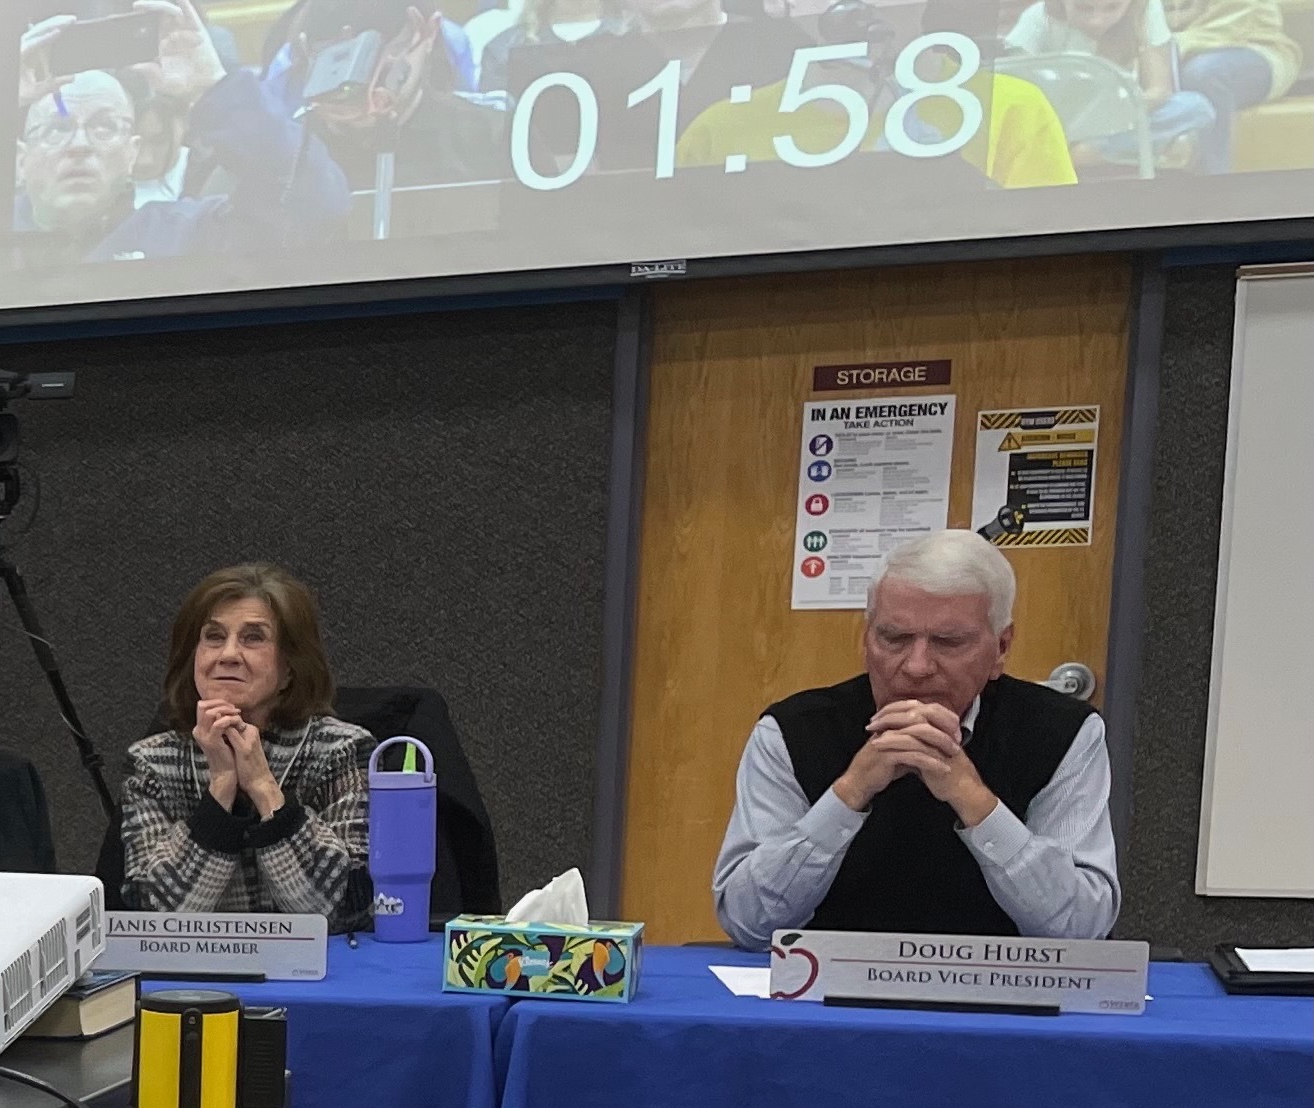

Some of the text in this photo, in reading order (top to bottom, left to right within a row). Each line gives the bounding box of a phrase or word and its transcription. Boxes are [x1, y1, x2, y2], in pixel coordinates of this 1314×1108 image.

[510, 32, 984, 190] 01:58
[836, 366, 927, 385] STORAGE
[811, 402, 949, 421] IN AN EMERGENCY
[844, 418, 914, 429] TAKE ACTION
[108, 917, 293, 935] JANIS CHRISTENSEN
[139, 939, 259, 955] BOARD MEMBER
[898, 940, 1067, 964] DOUG HURST
[867, 967, 1096, 990] BOARD VICE PRESIDENT
